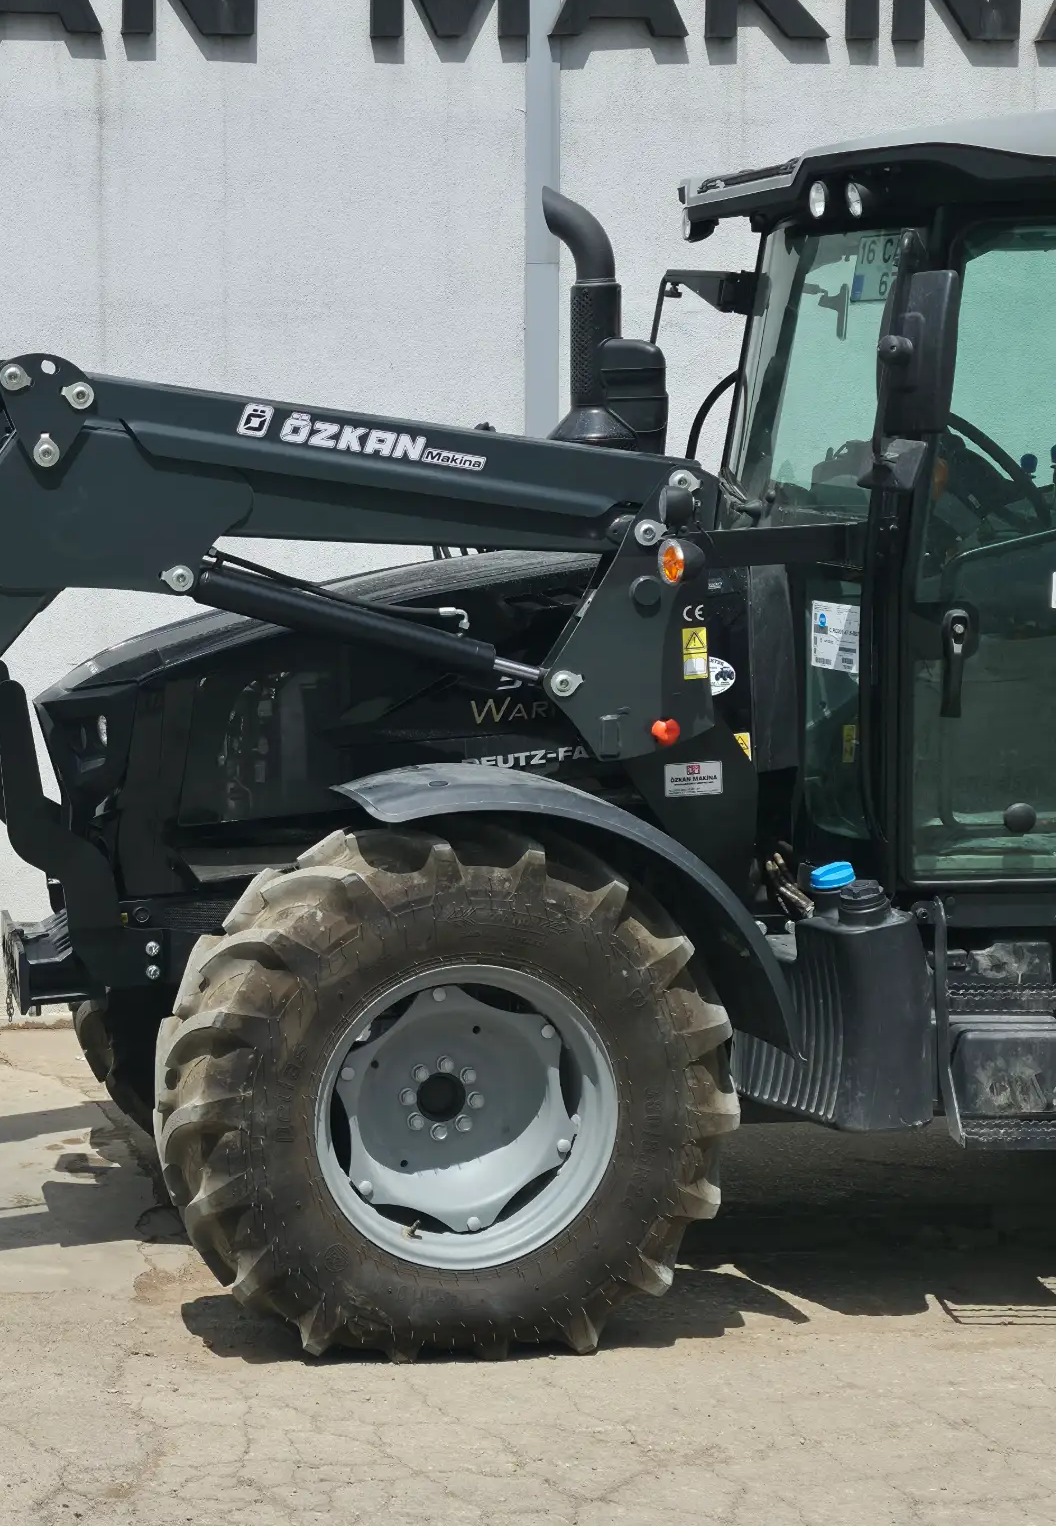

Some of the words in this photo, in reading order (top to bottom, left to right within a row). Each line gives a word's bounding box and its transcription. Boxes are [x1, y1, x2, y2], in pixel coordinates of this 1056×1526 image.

[860, 239, 877, 265] 16
[280, 412, 426, 461] ÖZKAN
[425, 450, 482, 469] Makina
[683, 604, 704, 621] CE
[470, 696, 557, 724] WAR
